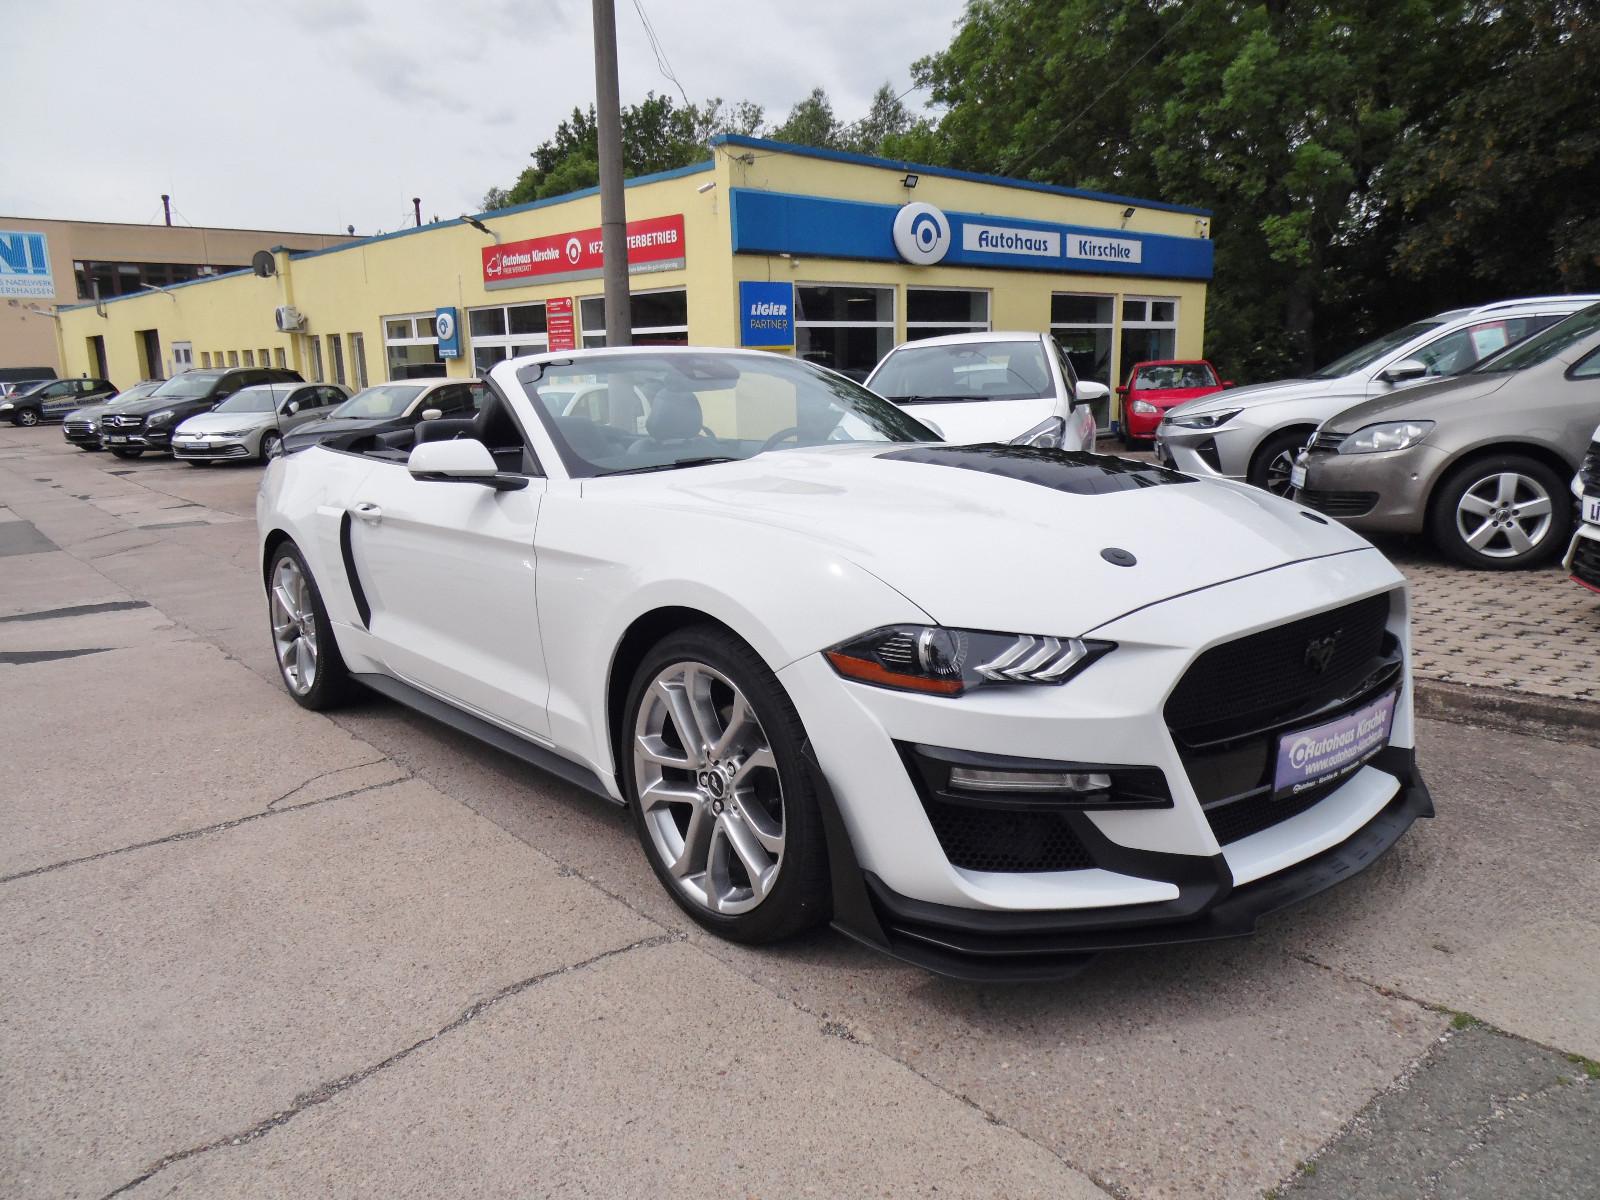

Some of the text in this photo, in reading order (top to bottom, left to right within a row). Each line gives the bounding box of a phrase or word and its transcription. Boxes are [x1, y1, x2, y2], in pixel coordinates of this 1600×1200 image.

[978, 230, 1131, 259] Autohaus Kirschke
[502, 247, 560, 267] Autohaus Kirschke
[6, 279, 53, 288] NADELWERK
[750, 319, 788, 329] PARTNER
[1304, 709, 1387, 761] Autohaus Kirschke
